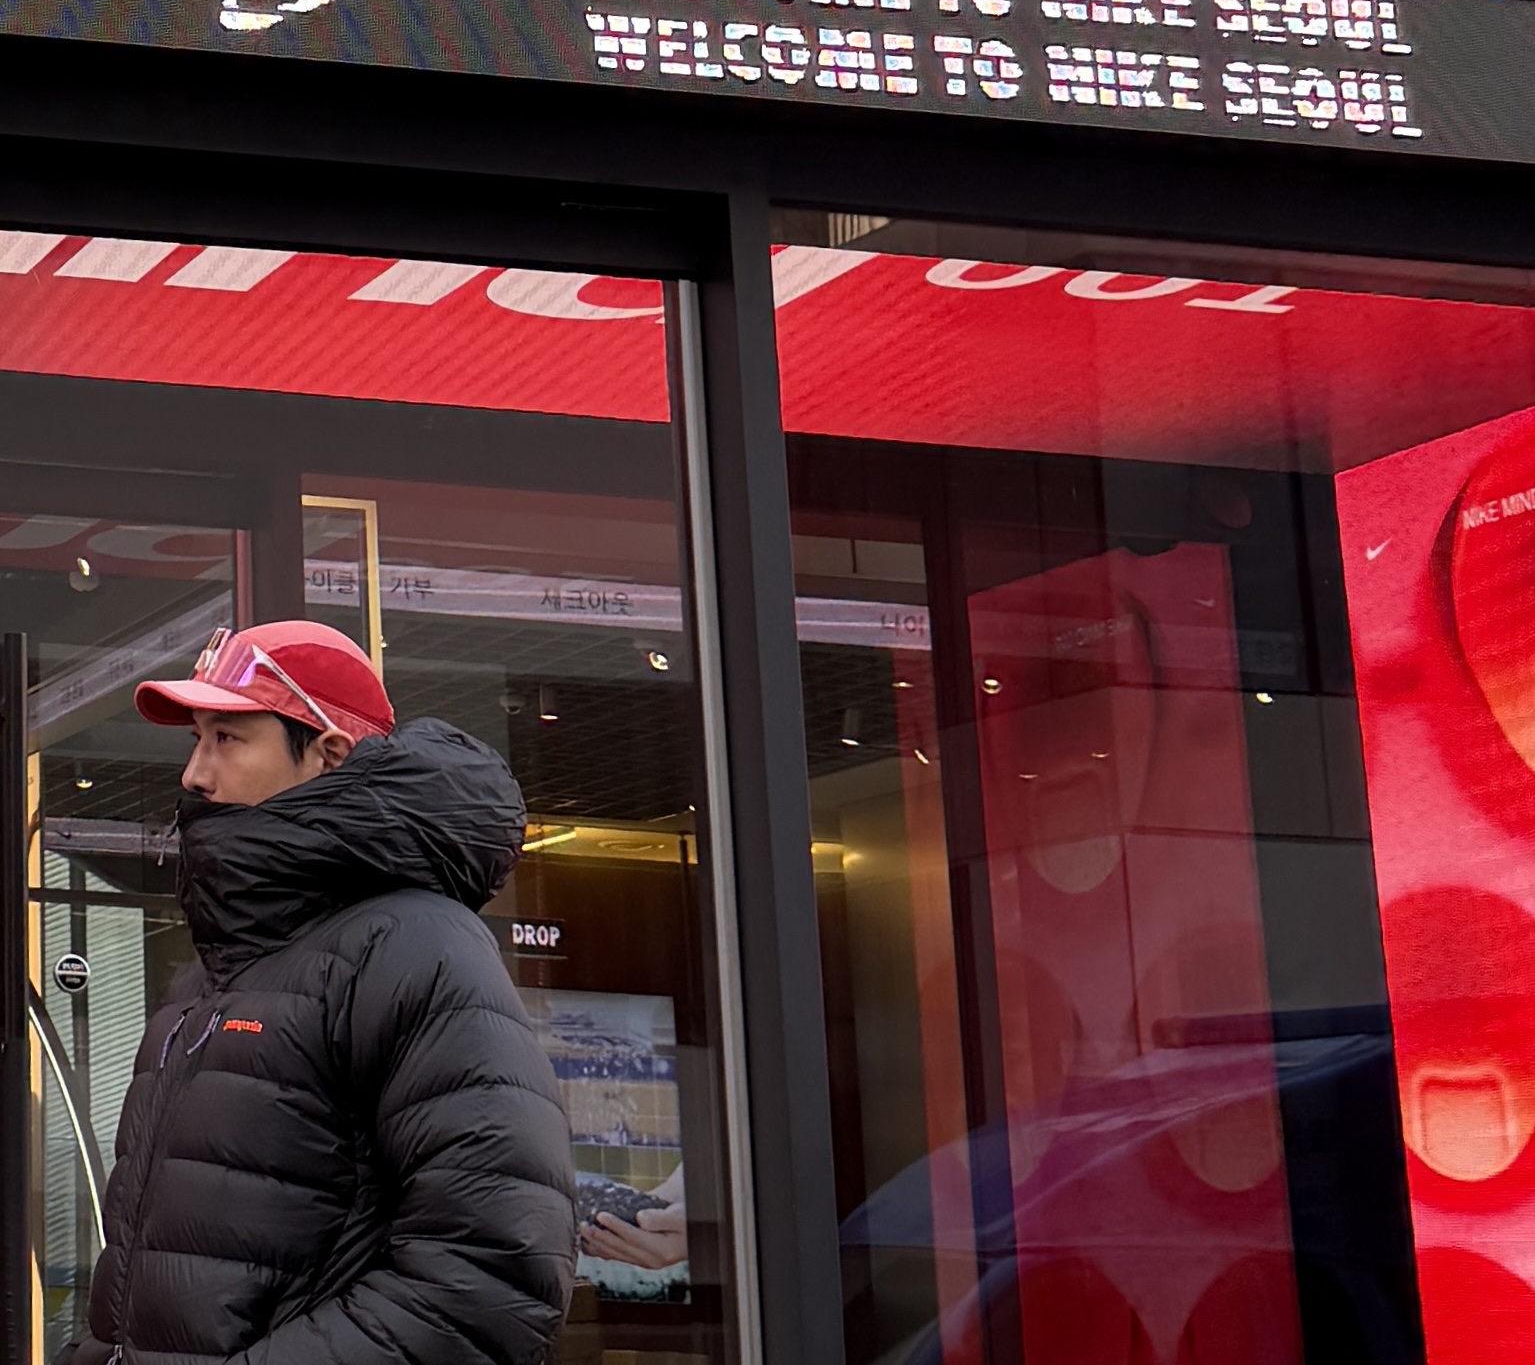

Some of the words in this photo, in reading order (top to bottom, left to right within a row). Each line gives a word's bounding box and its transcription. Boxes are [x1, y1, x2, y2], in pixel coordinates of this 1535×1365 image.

[584, 8, 919, 96] WELCOME
[934, 35, 1023, 99] TO
[1045, 45, 1205, 111] NIKE
[1222, 61, 1423, 138] SEOUL
[305, 569, 357, 595] 이클
[511, 923, 561, 948] DROP
